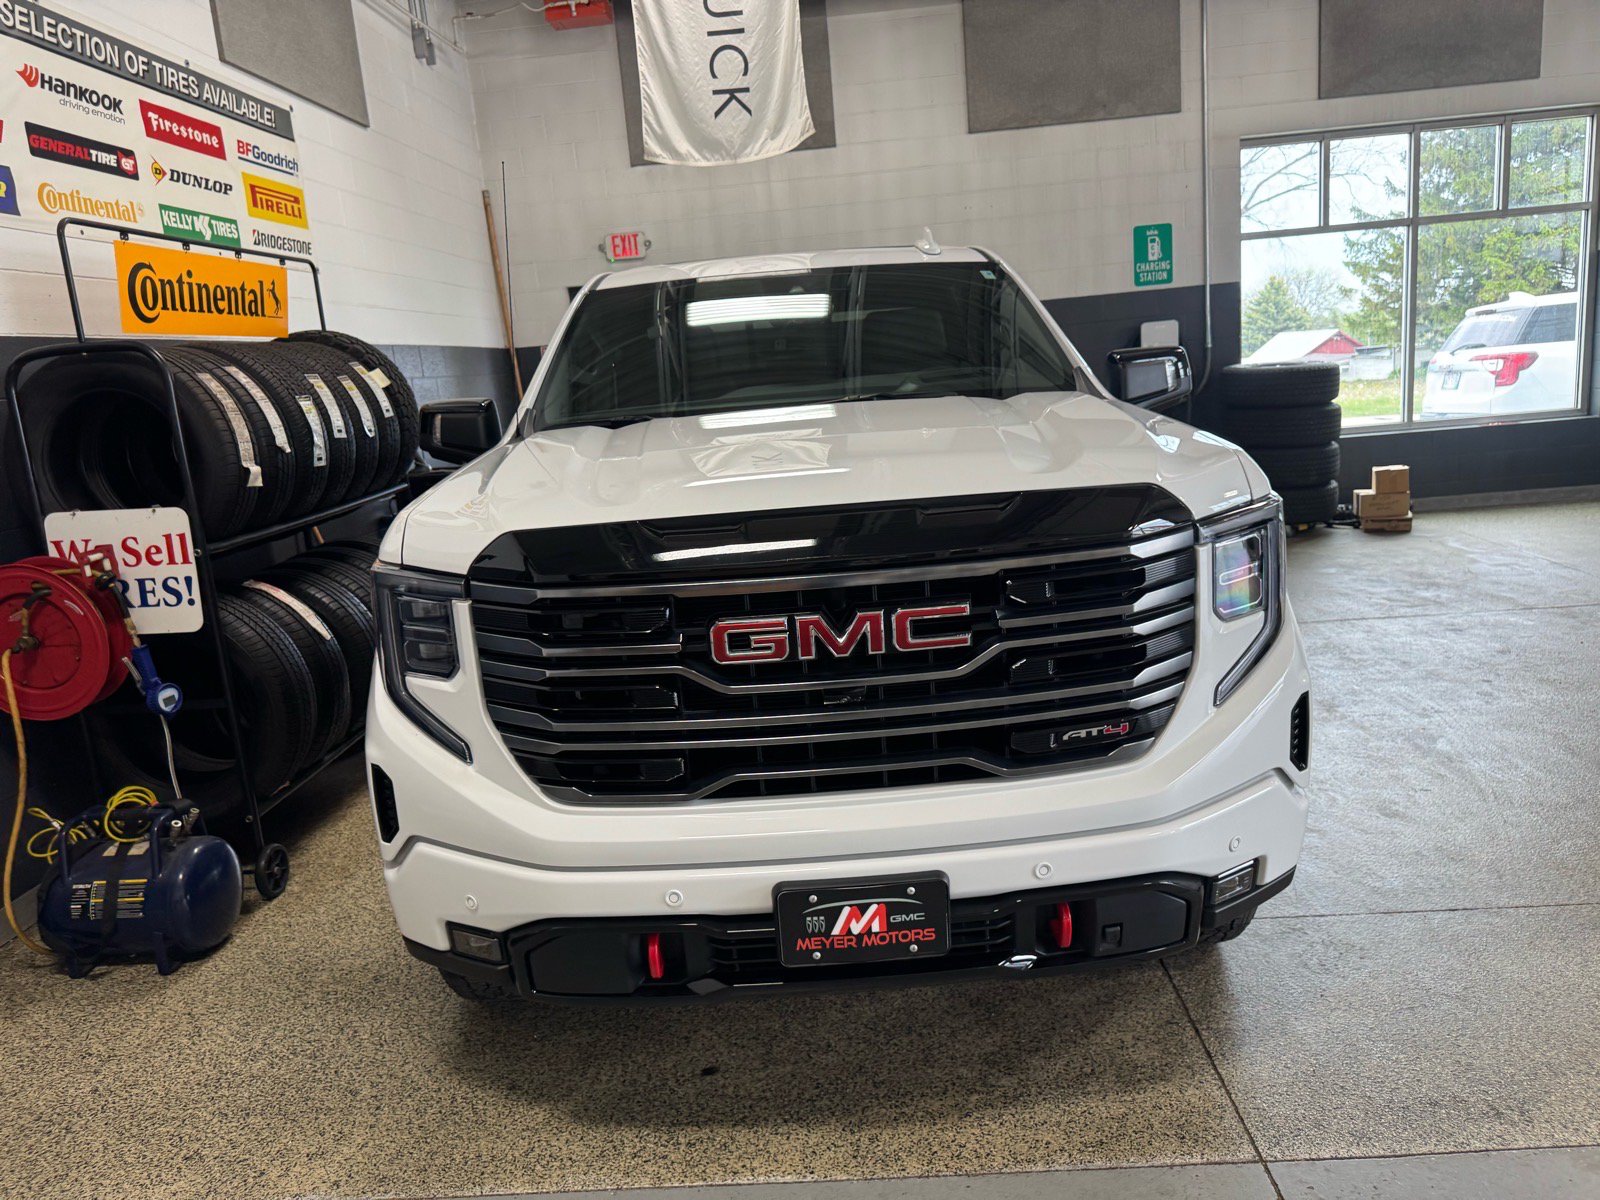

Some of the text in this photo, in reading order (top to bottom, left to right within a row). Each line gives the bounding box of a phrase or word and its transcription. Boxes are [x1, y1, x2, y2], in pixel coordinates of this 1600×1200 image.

[0, 0, 276, 128] SELECTION OF TIRES AVAILABLE!
[703, 0, 753, 119] UICK
[59, 97, 126, 125] driving emotion
[148, 110, 220, 149] Firestone
[237, 139, 299, 173] BFGoodrich
[169, 168, 233, 196] DUNLOP
[37, 182, 138, 223] Continental
[249, 183, 303, 219] PIRELLI
[161, 209, 194, 231] KELLY
[210, 219, 239, 239] TIRES
[252, 229, 313, 256] BRIDGESTONE
[611, 233, 640, 257] EXIT
[1136, 261, 1170, 272] CHARGING
[1140, 271, 1168, 282] STATION
[128, 261, 266, 324] Continental
[121, 532, 193, 568] Sell
[117, 575, 196, 609] RES!
[709, 602, 973, 665] GMC
[1062, 722, 1129, 741] AT4
[890, 912, 926, 924] GMC
[796, 927, 936, 951] MEYER MOTORS
